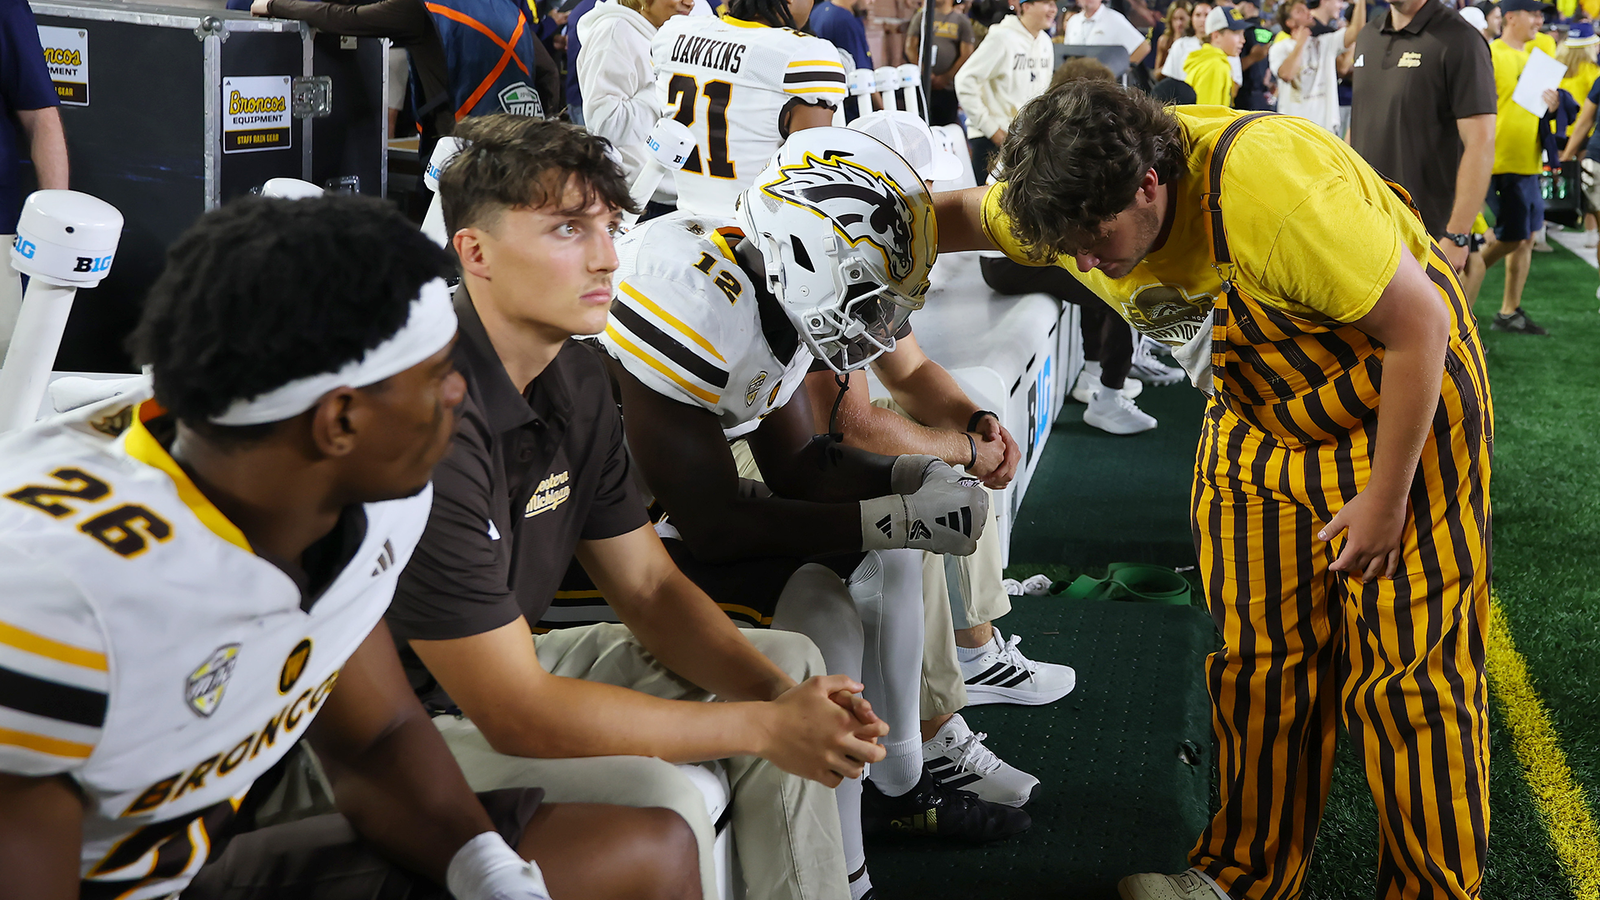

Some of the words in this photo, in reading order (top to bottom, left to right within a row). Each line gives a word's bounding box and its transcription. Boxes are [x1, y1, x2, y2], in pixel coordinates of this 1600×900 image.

[44, 47, 82, 66] ncos
[671, 34, 746, 74] DAWKINS
[229, 90, 286, 115] Broncos
[233, 115, 283, 125] EQUIPMENT
[667, 73, 738, 180] 21
[237, 135, 252, 145] STAFF
[267, 133, 279, 143] GEAR
[692, 251, 743, 306] 12
[535, 470, 569, 495] estern
[2, 467, 175, 560] 26
